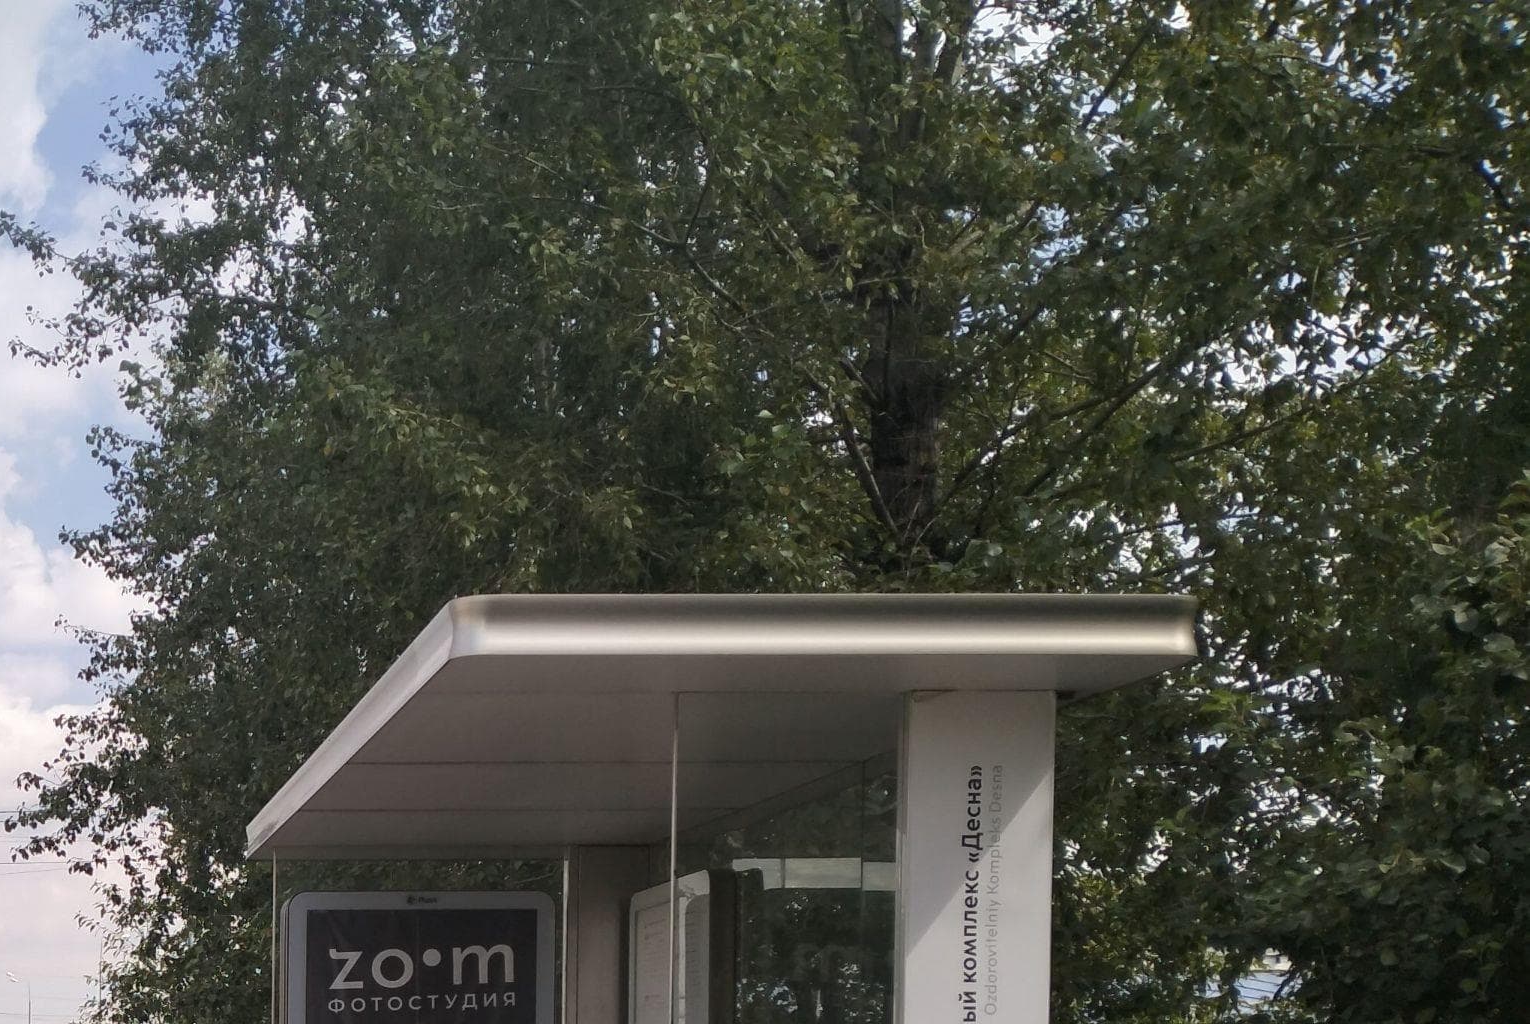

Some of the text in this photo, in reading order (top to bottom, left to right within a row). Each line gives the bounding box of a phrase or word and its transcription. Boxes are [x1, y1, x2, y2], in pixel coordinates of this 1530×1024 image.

[961, 764, 984, 862] «Десна»
[963, 869, 981, 984] комплекс
[983, 764, 1004, 1016] Ozdorovitelniy Kompleks Desna
[328, 991, 517, 1014] ФОТОСТУДИЯ
